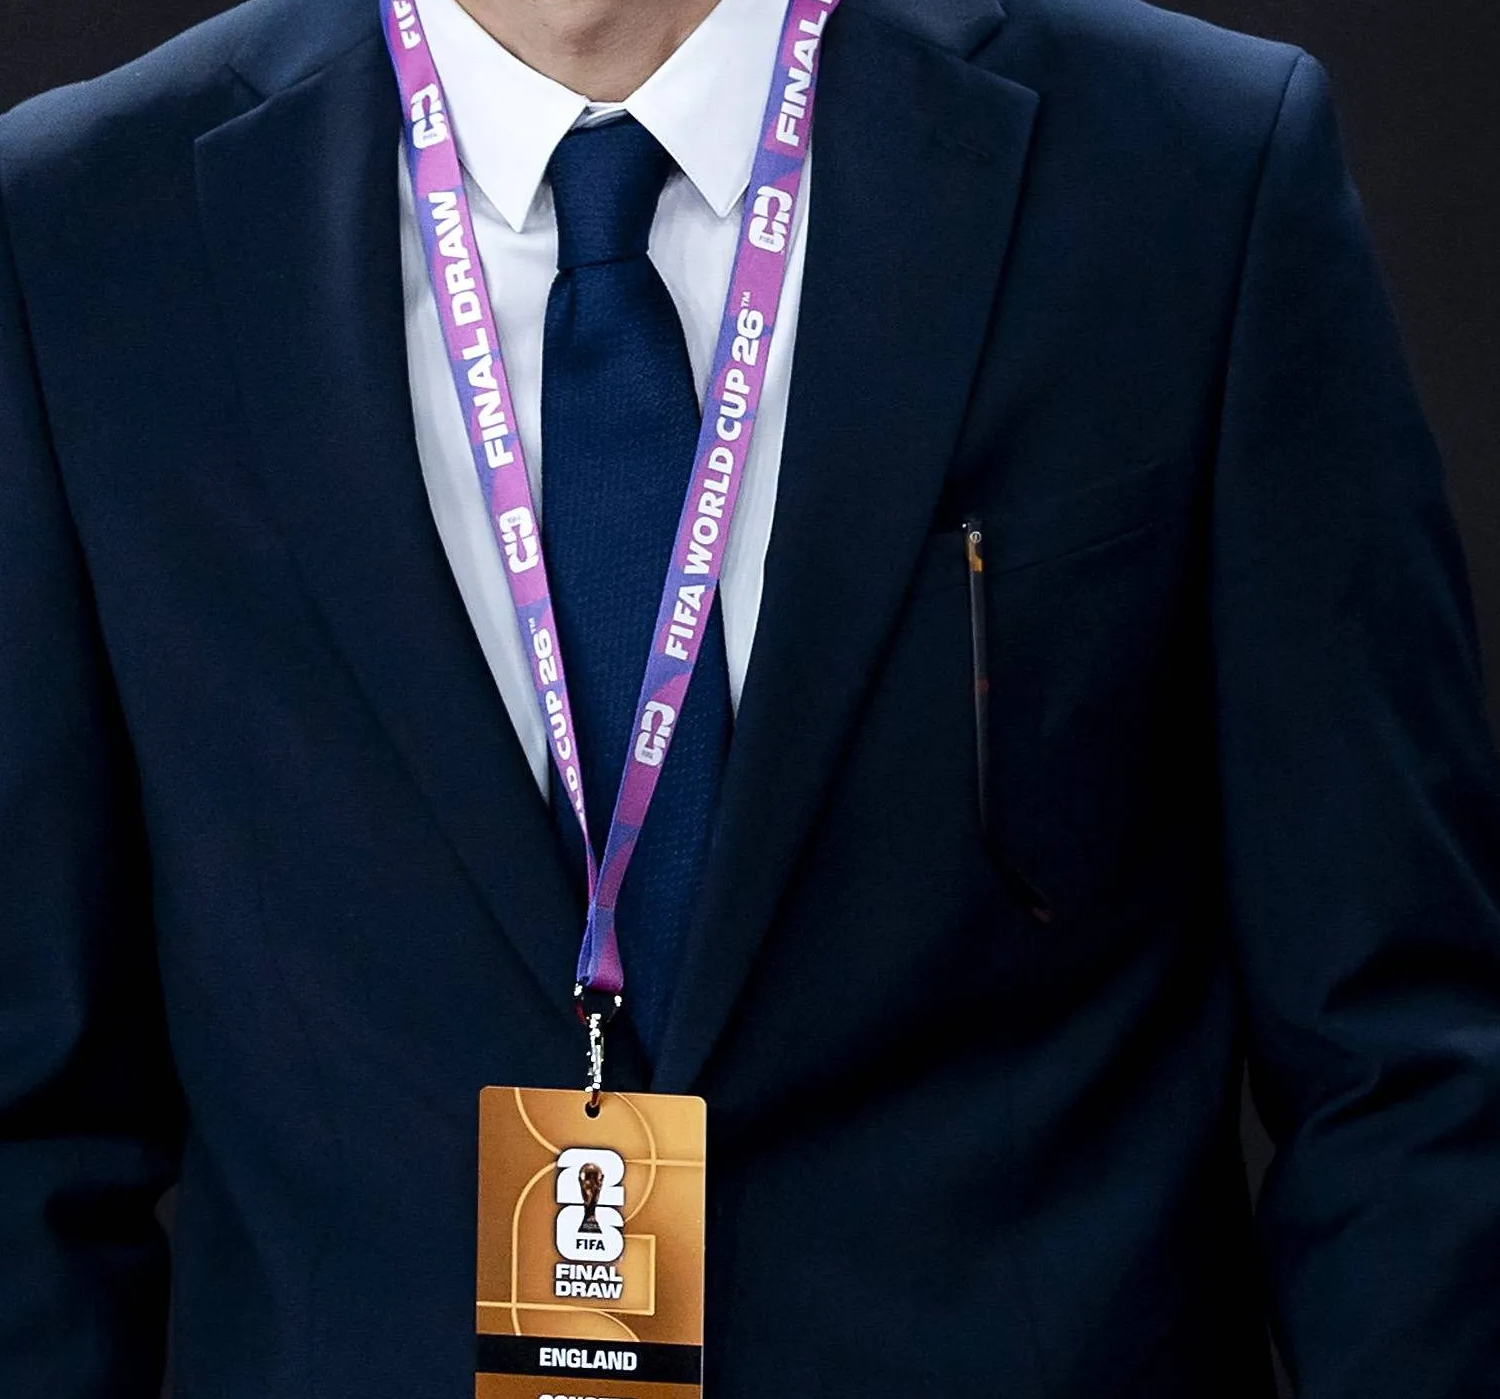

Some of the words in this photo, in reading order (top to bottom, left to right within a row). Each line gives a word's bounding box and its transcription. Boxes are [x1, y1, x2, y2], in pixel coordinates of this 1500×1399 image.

[775, 9, 827, 147] FINAL
[428, 191, 483, 326] DRAW
[462, 327, 514, 468] FINAL
[716, 368, 751, 441] CUP
[684, 446, 733, 577] WORLD
[665, 584, 706, 661] FIFA
[545, 690, 572, 760] CUP
[555, 1263, 623, 1282] FINAL
[575, 1238, 606, 1251] FIFA
[555, 1280, 623, 1299] DRAW
[539, 1347, 638, 1371] ENGLAND
